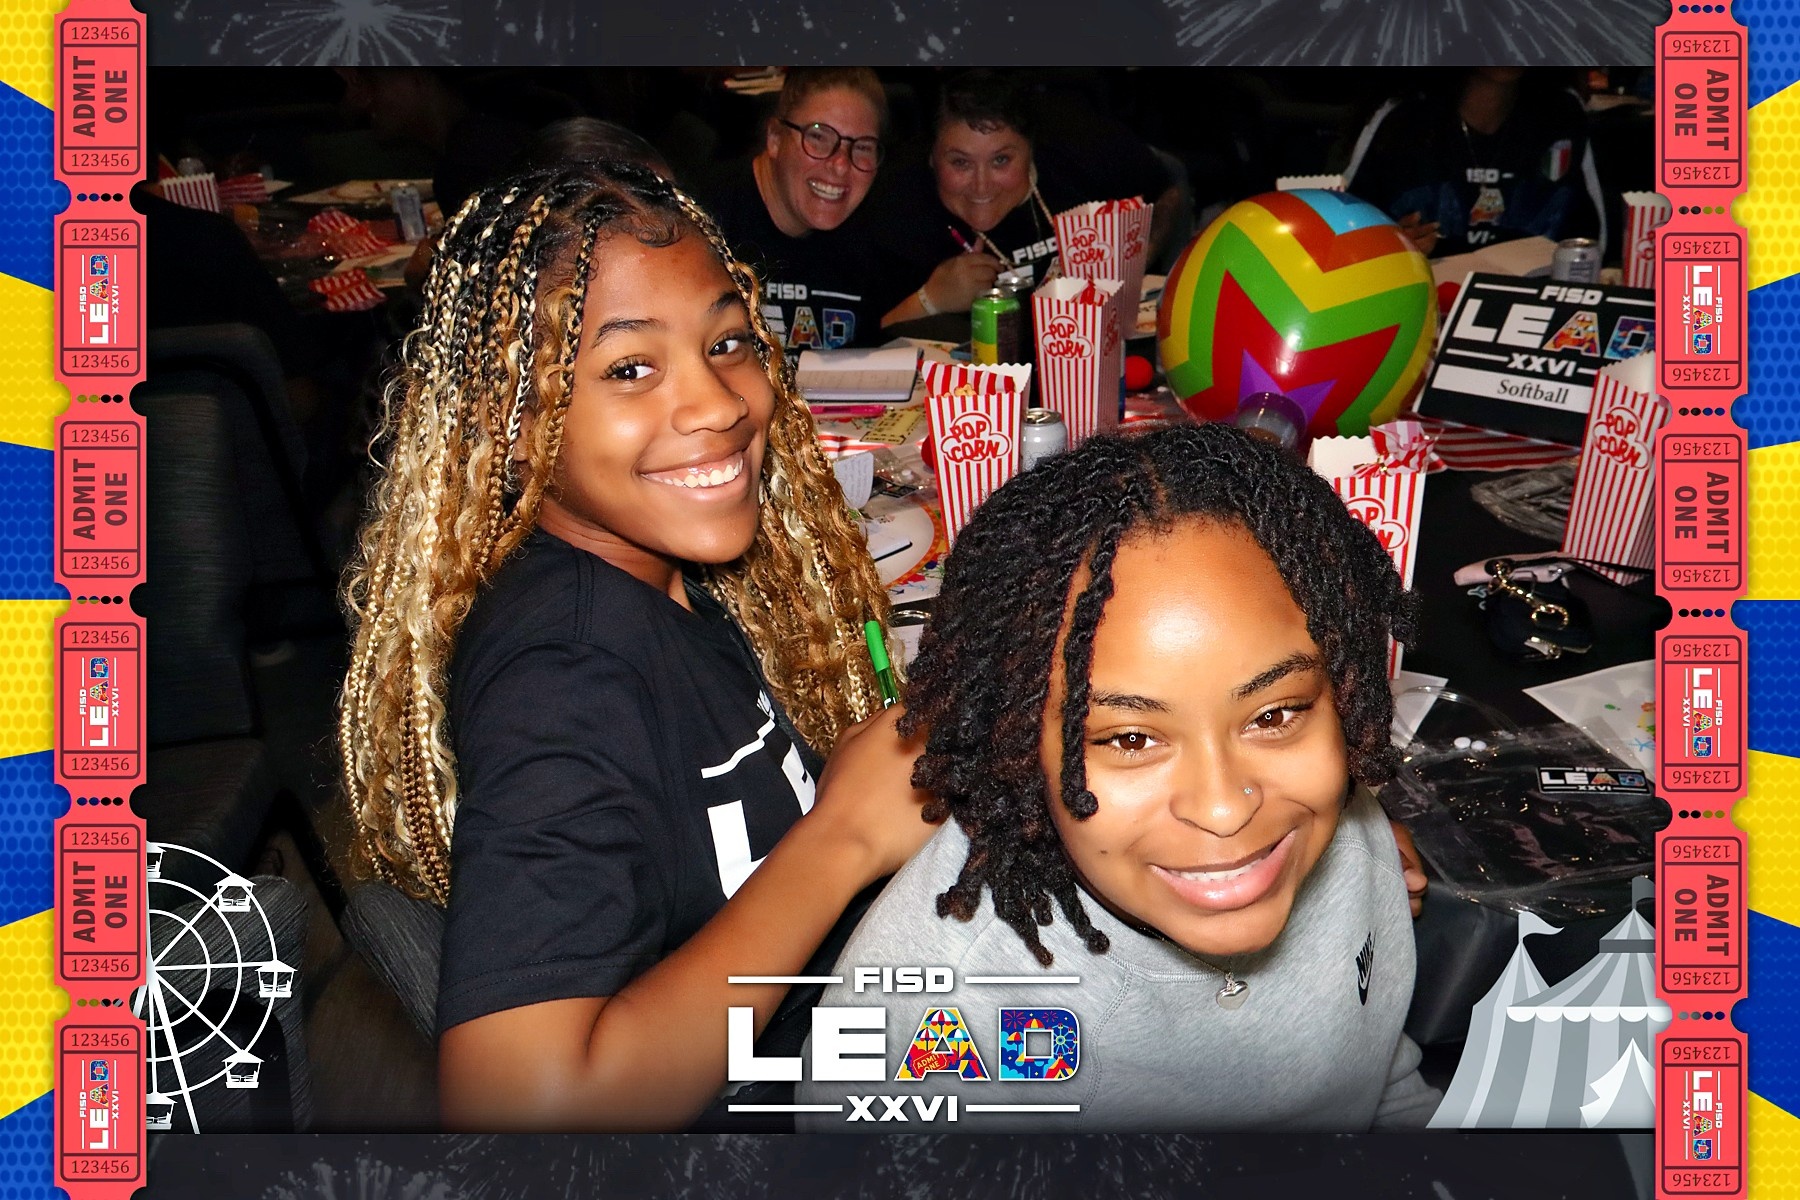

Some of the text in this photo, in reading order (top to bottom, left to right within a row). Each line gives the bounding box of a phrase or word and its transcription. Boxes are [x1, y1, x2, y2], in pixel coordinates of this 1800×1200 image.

[1466, 167, 1500, 184] ISD
[1012, 236, 1057, 265] FISD
[1072, 234, 1095, 249] POP
[1073, 248, 1105, 264] CORN
[766, 282, 808, 300] FISD
[1540, 285, 1603, 305] FISD
[760, 304, 856, 349] EAD
[1049, 322, 1075, 340] POP
[1452, 298, 1656, 360] LEAD
[1048, 340, 1085, 358] CORN
[1507, 352, 1577, 377] XXVI
[1497, 379, 1569, 405] Softball
[949, 420, 987, 443] POP
[1606, 413, 1636, 438] POP
[950, 440, 1000, 463] CORN
[1598, 436, 1641, 467] CORN
[1348, 507, 1379, 528] OP
[1541, 771, 1646, 787] LEAD
